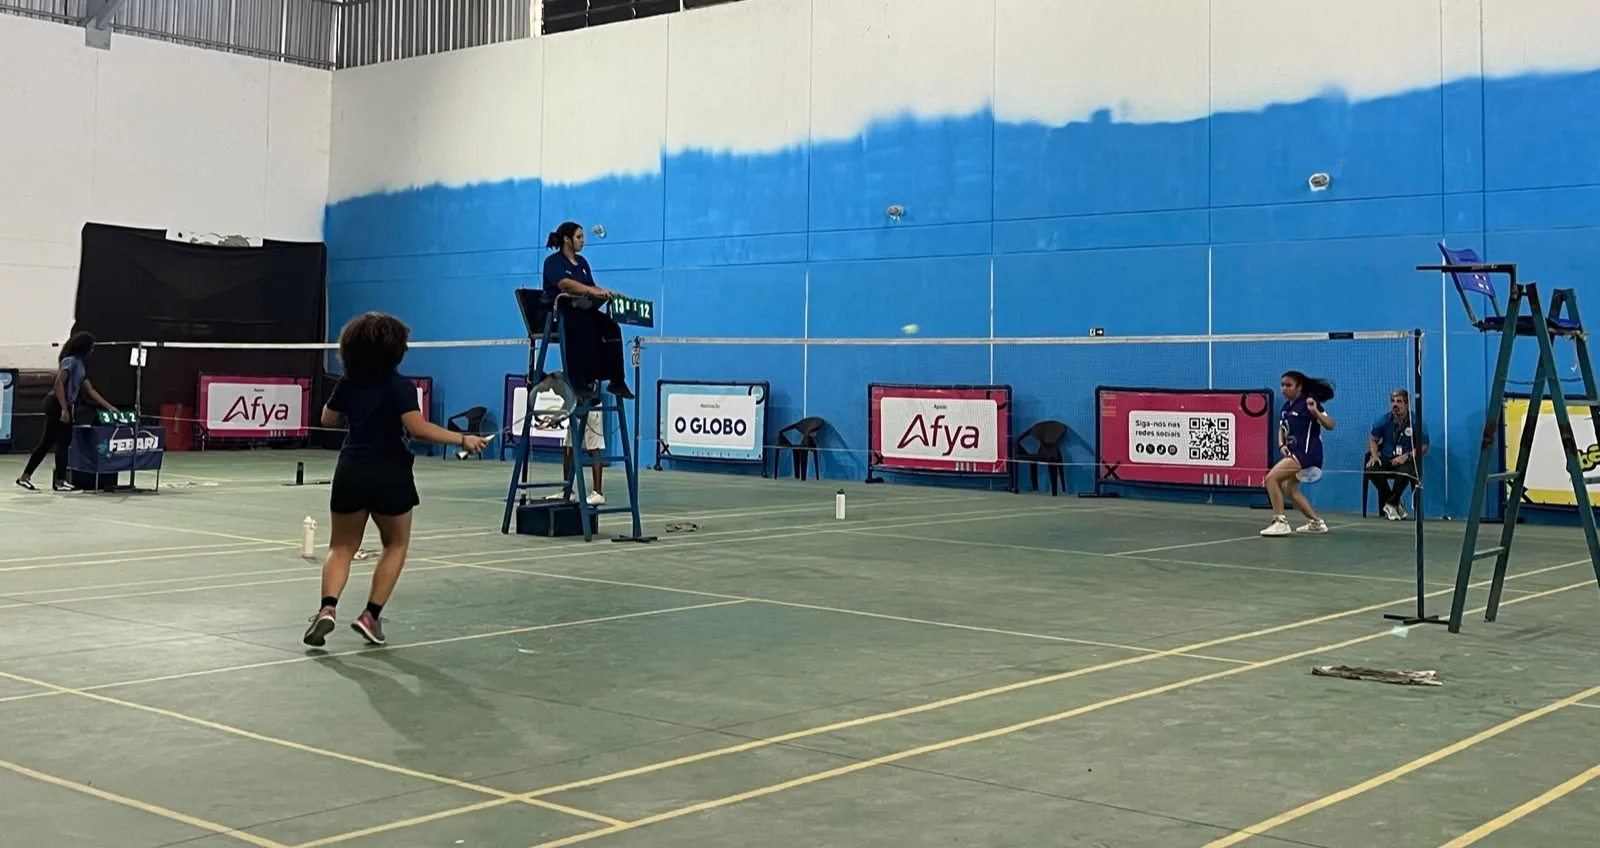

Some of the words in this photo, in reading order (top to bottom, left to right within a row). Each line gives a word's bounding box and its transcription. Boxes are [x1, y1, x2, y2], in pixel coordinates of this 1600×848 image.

[614, 299, 624, 314] 13
[640, 304, 650, 318] 12
[222, 395, 289, 427] Afya
[674, 416, 687, 434] O
[690, 417, 747, 437] GLOBO
[897, 414, 980, 456] Afya
